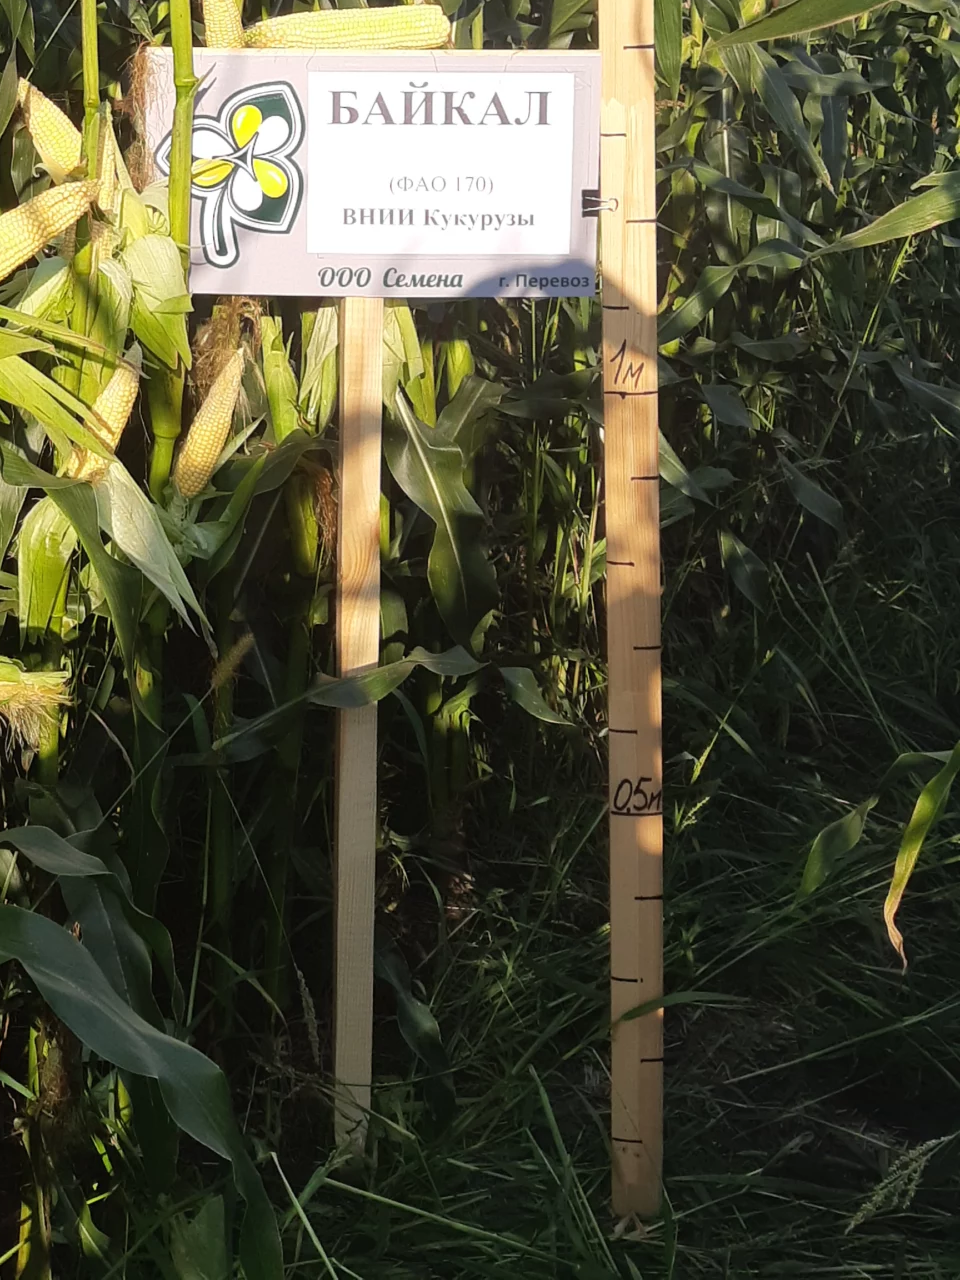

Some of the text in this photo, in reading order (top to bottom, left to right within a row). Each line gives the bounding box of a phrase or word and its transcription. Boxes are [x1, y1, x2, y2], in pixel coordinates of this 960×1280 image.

[327, 81, 552, 126] БАЙКАЛ
[389, 175, 494, 195] (ФАО 170)
[342, 208, 535, 231] ВНИИ Кукурузы
[318, 267, 464, 288] ООО Семена
[498, 274, 590, 290] г. Перевоз
